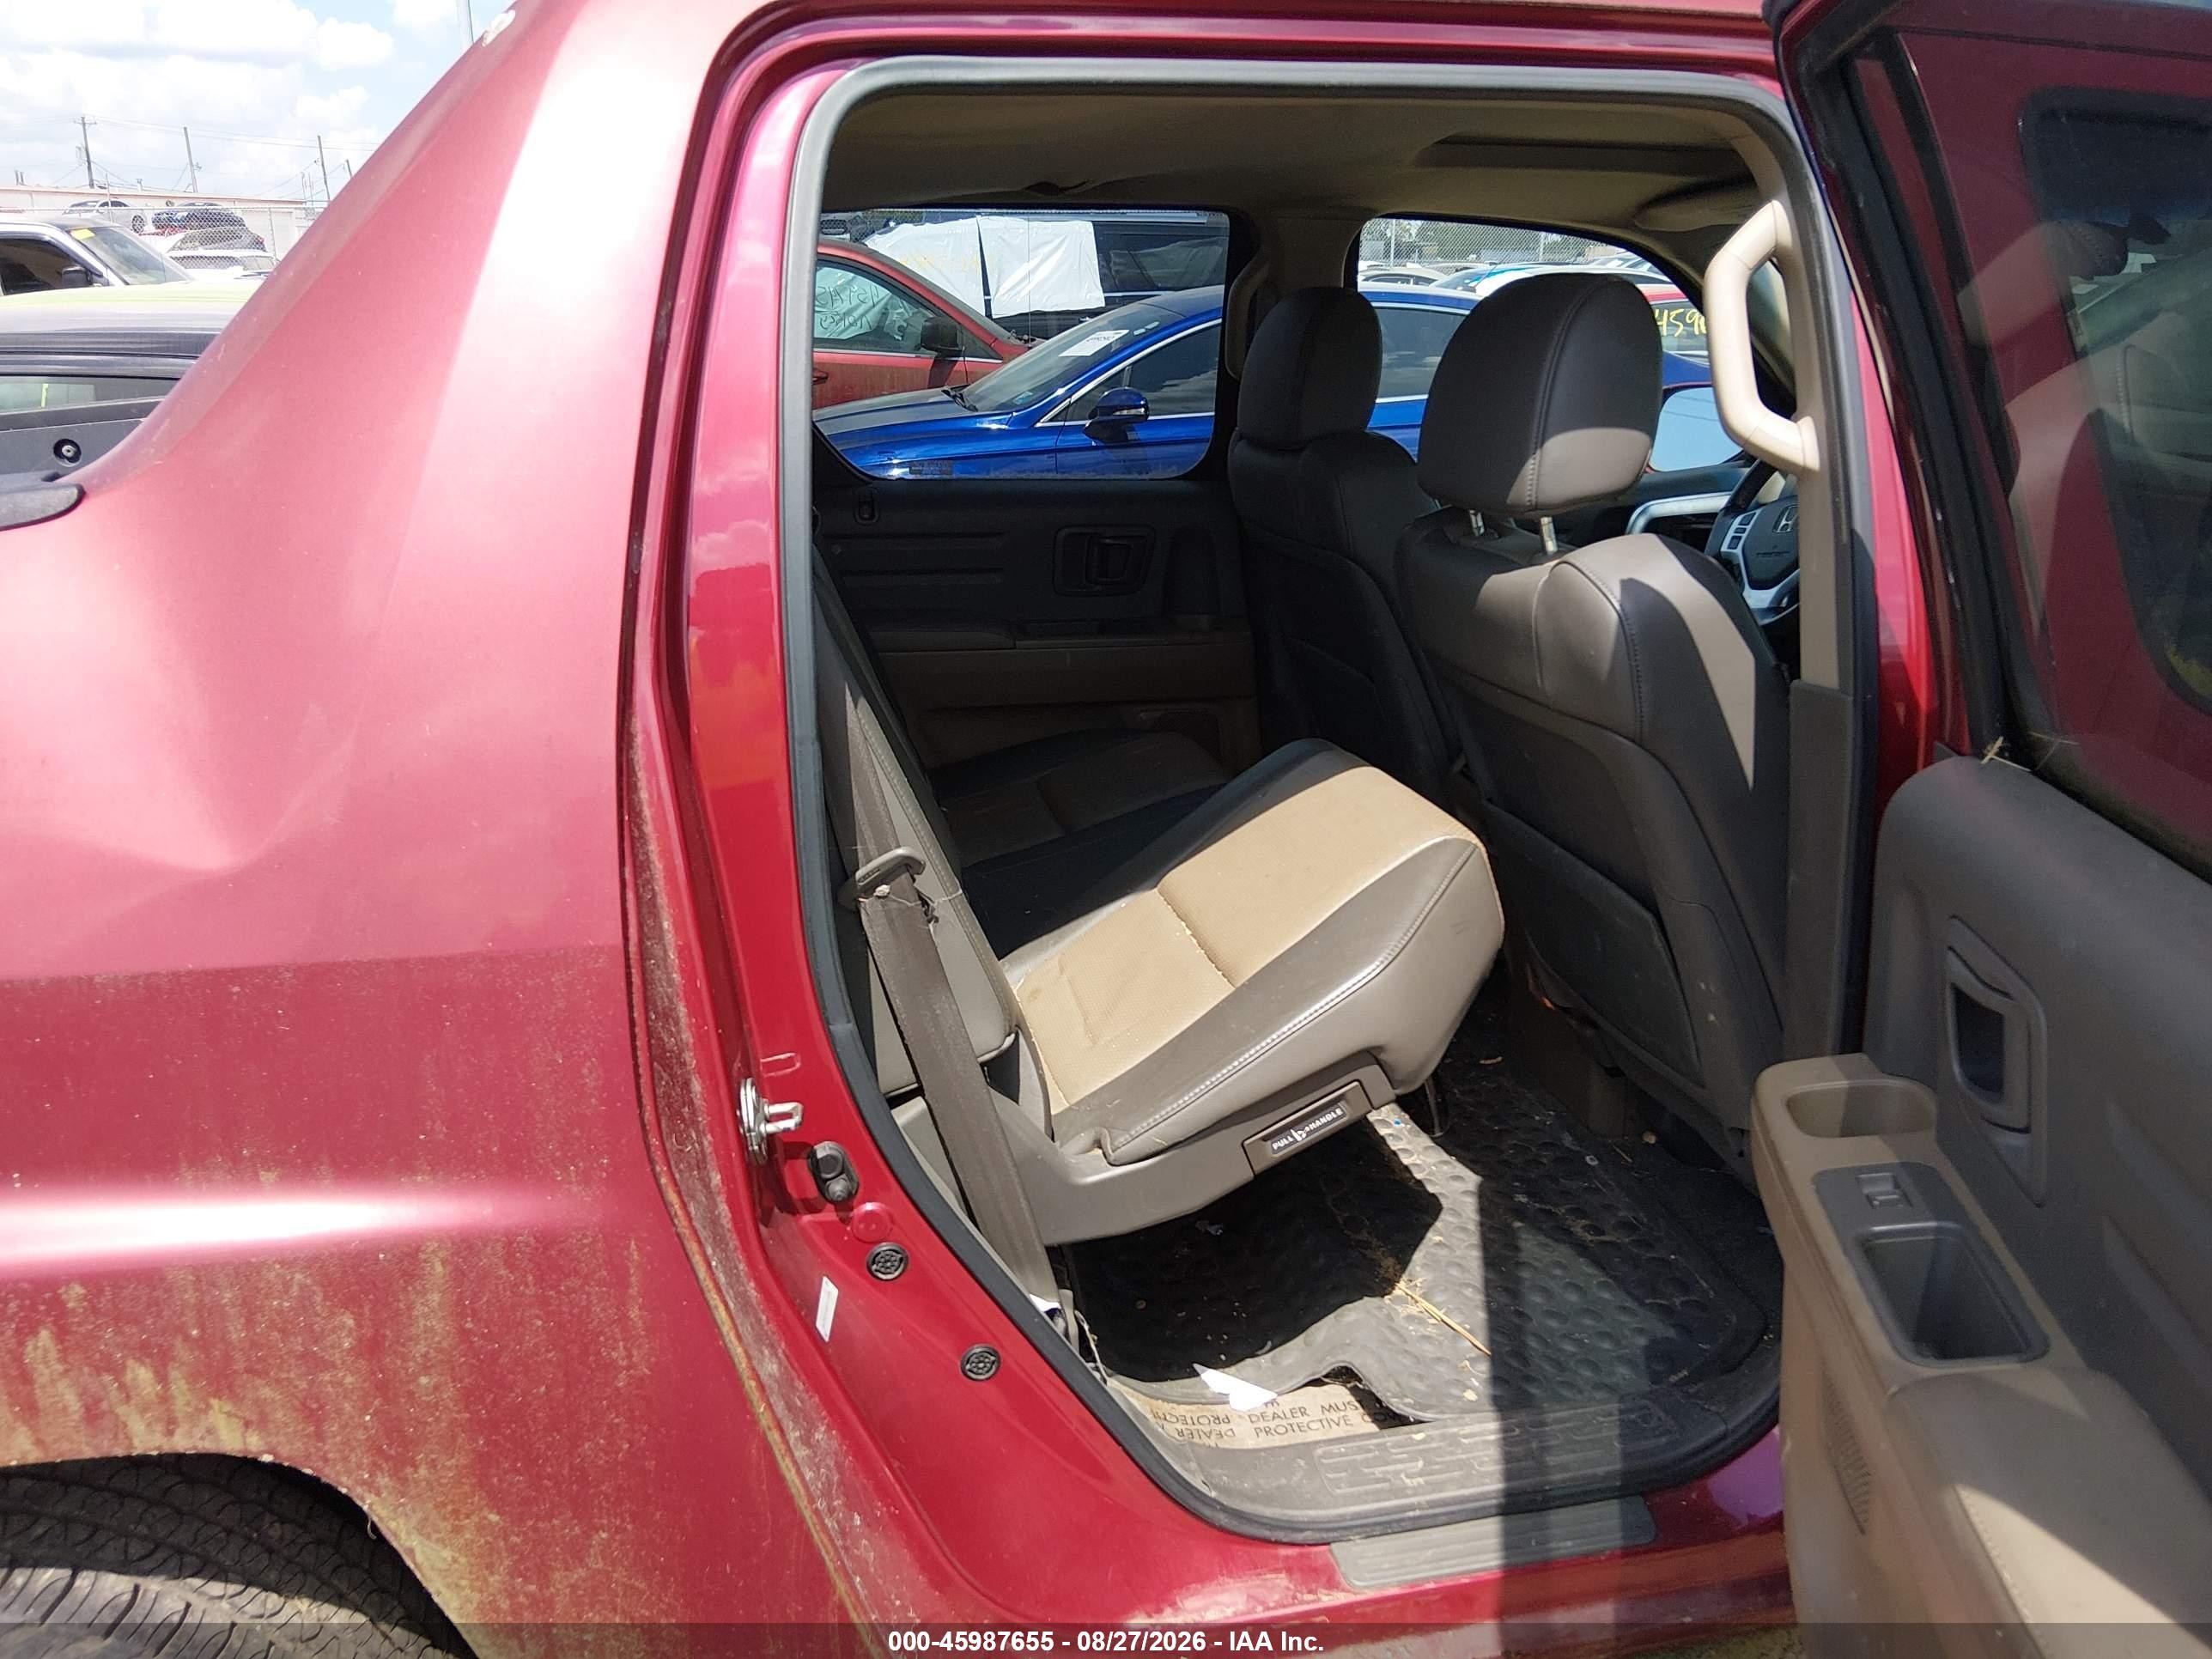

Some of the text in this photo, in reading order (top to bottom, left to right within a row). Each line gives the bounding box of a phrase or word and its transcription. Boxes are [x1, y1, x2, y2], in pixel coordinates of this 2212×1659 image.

[1272, 1107, 1344, 1151] PULL HANDLE
[1249, 1406, 1310, 1424] DEALER
[1254, 1414, 1354, 1437] PROTECTIVE
